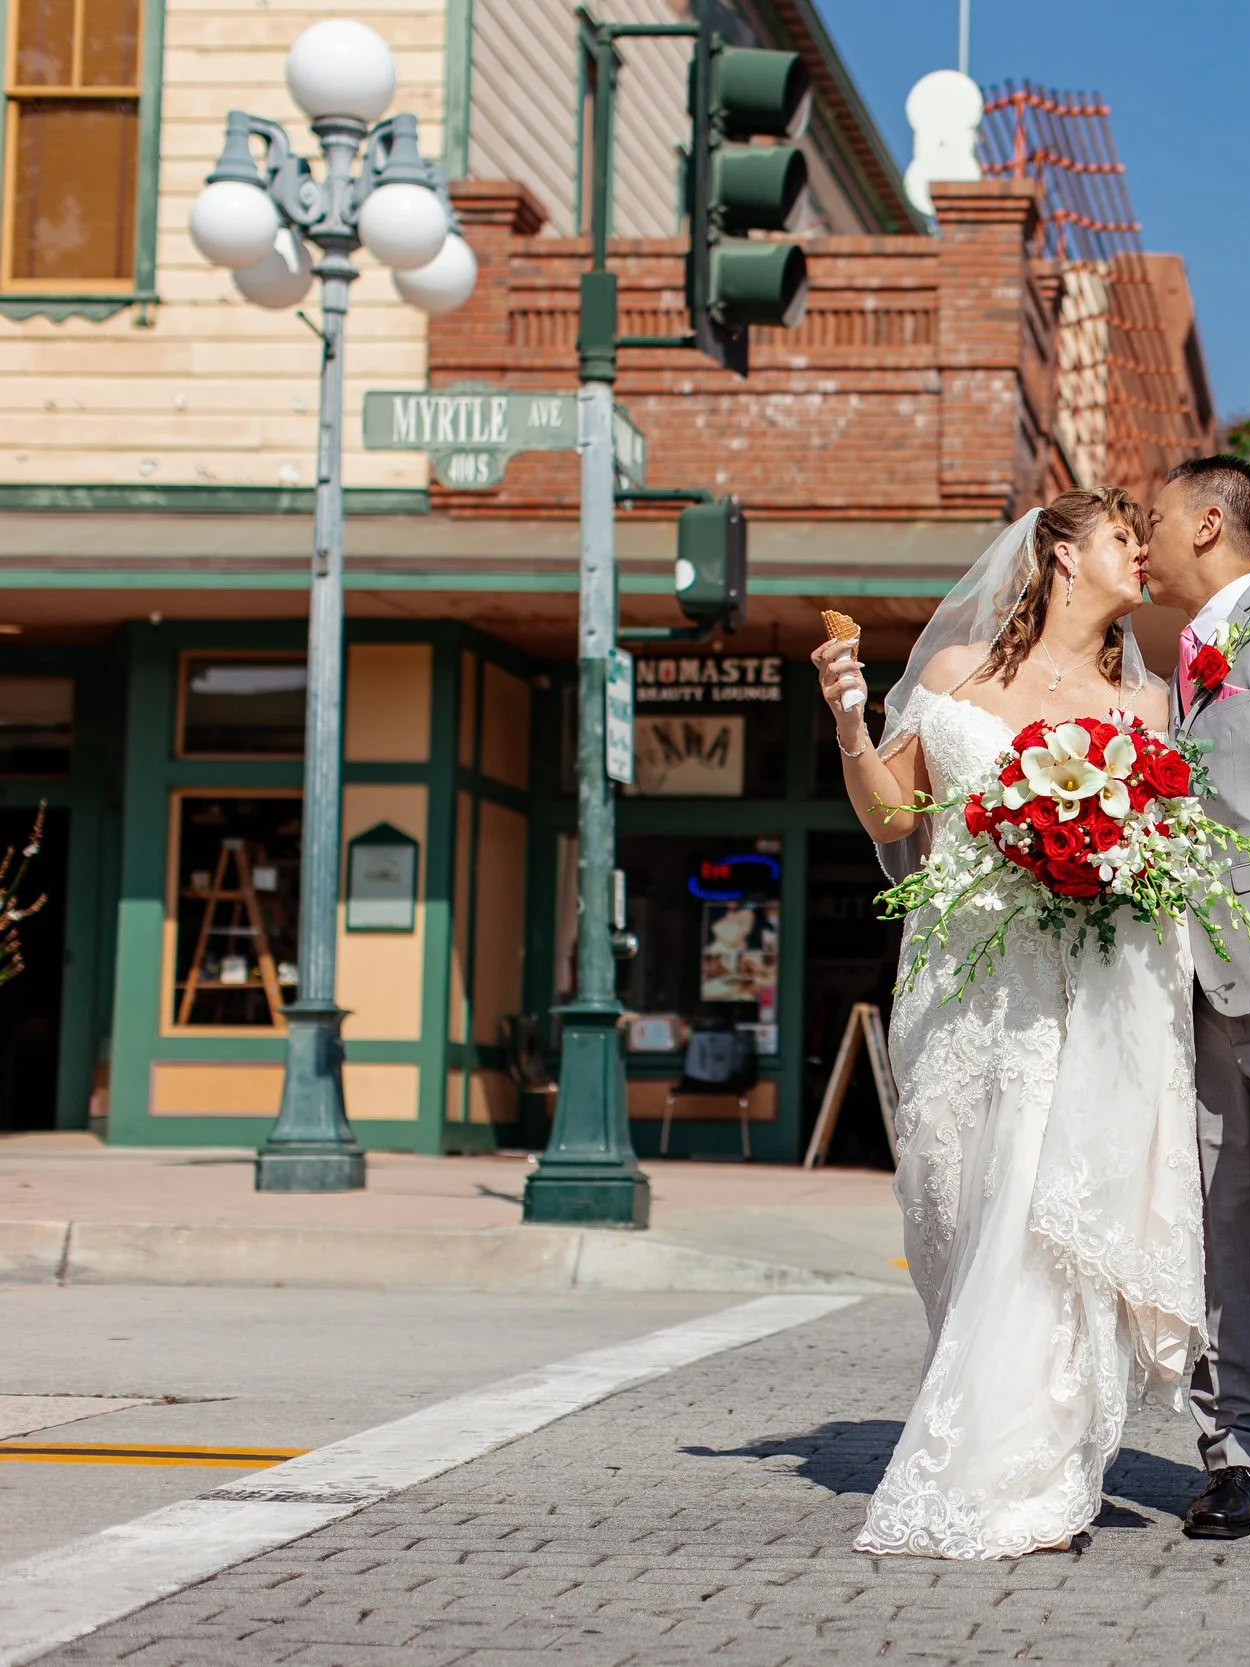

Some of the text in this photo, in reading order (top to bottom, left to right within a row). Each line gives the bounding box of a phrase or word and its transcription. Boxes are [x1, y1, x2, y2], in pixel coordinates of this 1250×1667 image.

[392, 396, 563, 443] MYRTLE AVE
[636, 658, 782, 683] NOMASTE
[636, 685, 704, 701] BEAUTY
